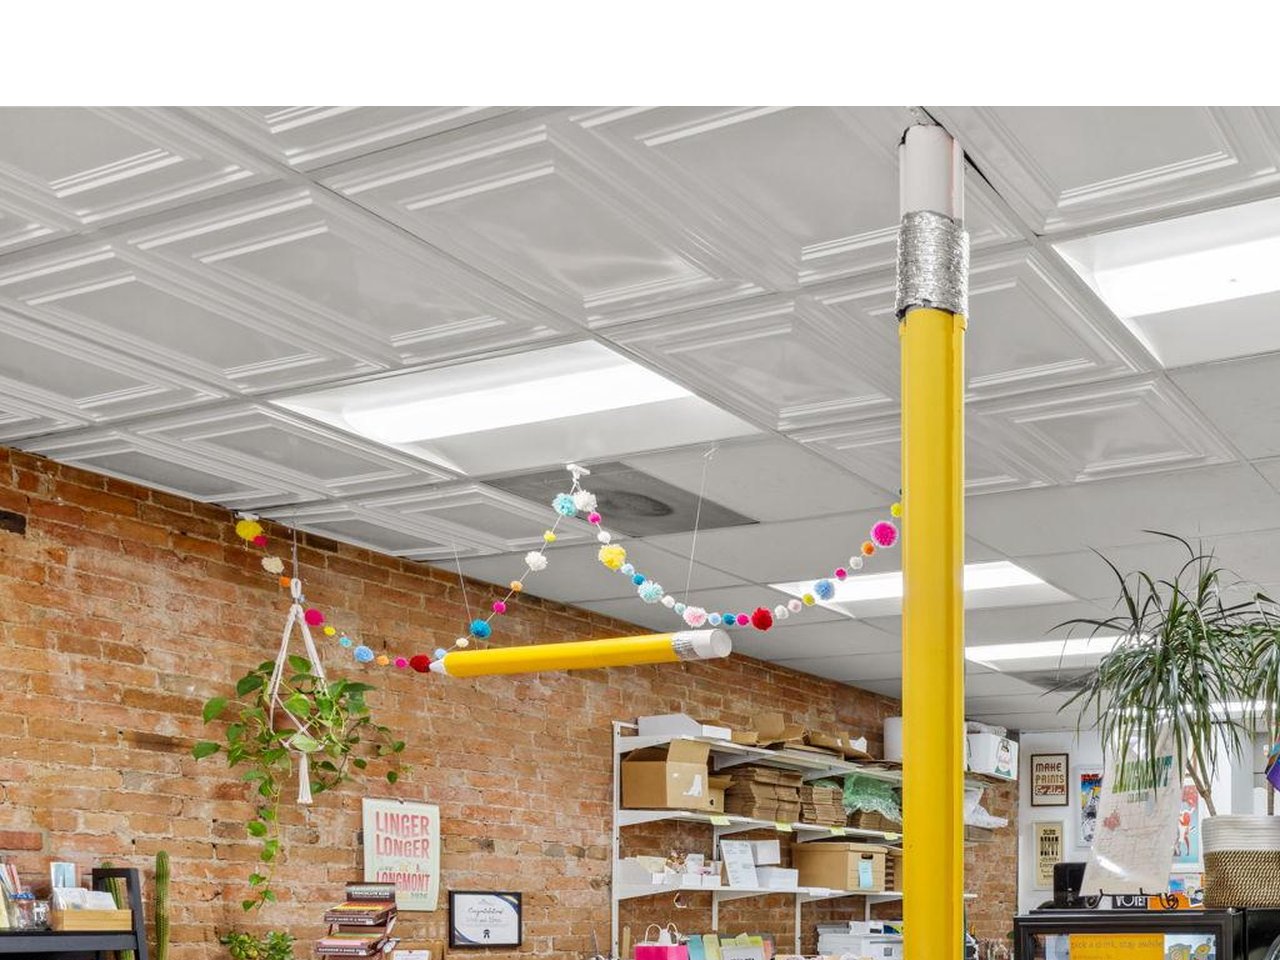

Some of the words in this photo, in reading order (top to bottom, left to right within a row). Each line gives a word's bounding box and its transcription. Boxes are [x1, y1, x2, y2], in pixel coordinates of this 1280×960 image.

[1036, 763, 1062, 772] MAKE
[1036, 774, 1064, 784] PRINTS
[375, 811, 430, 838] LINGER
[375, 834, 430, 859] LONGER
[376, 871, 430, 892] LONGMONT
